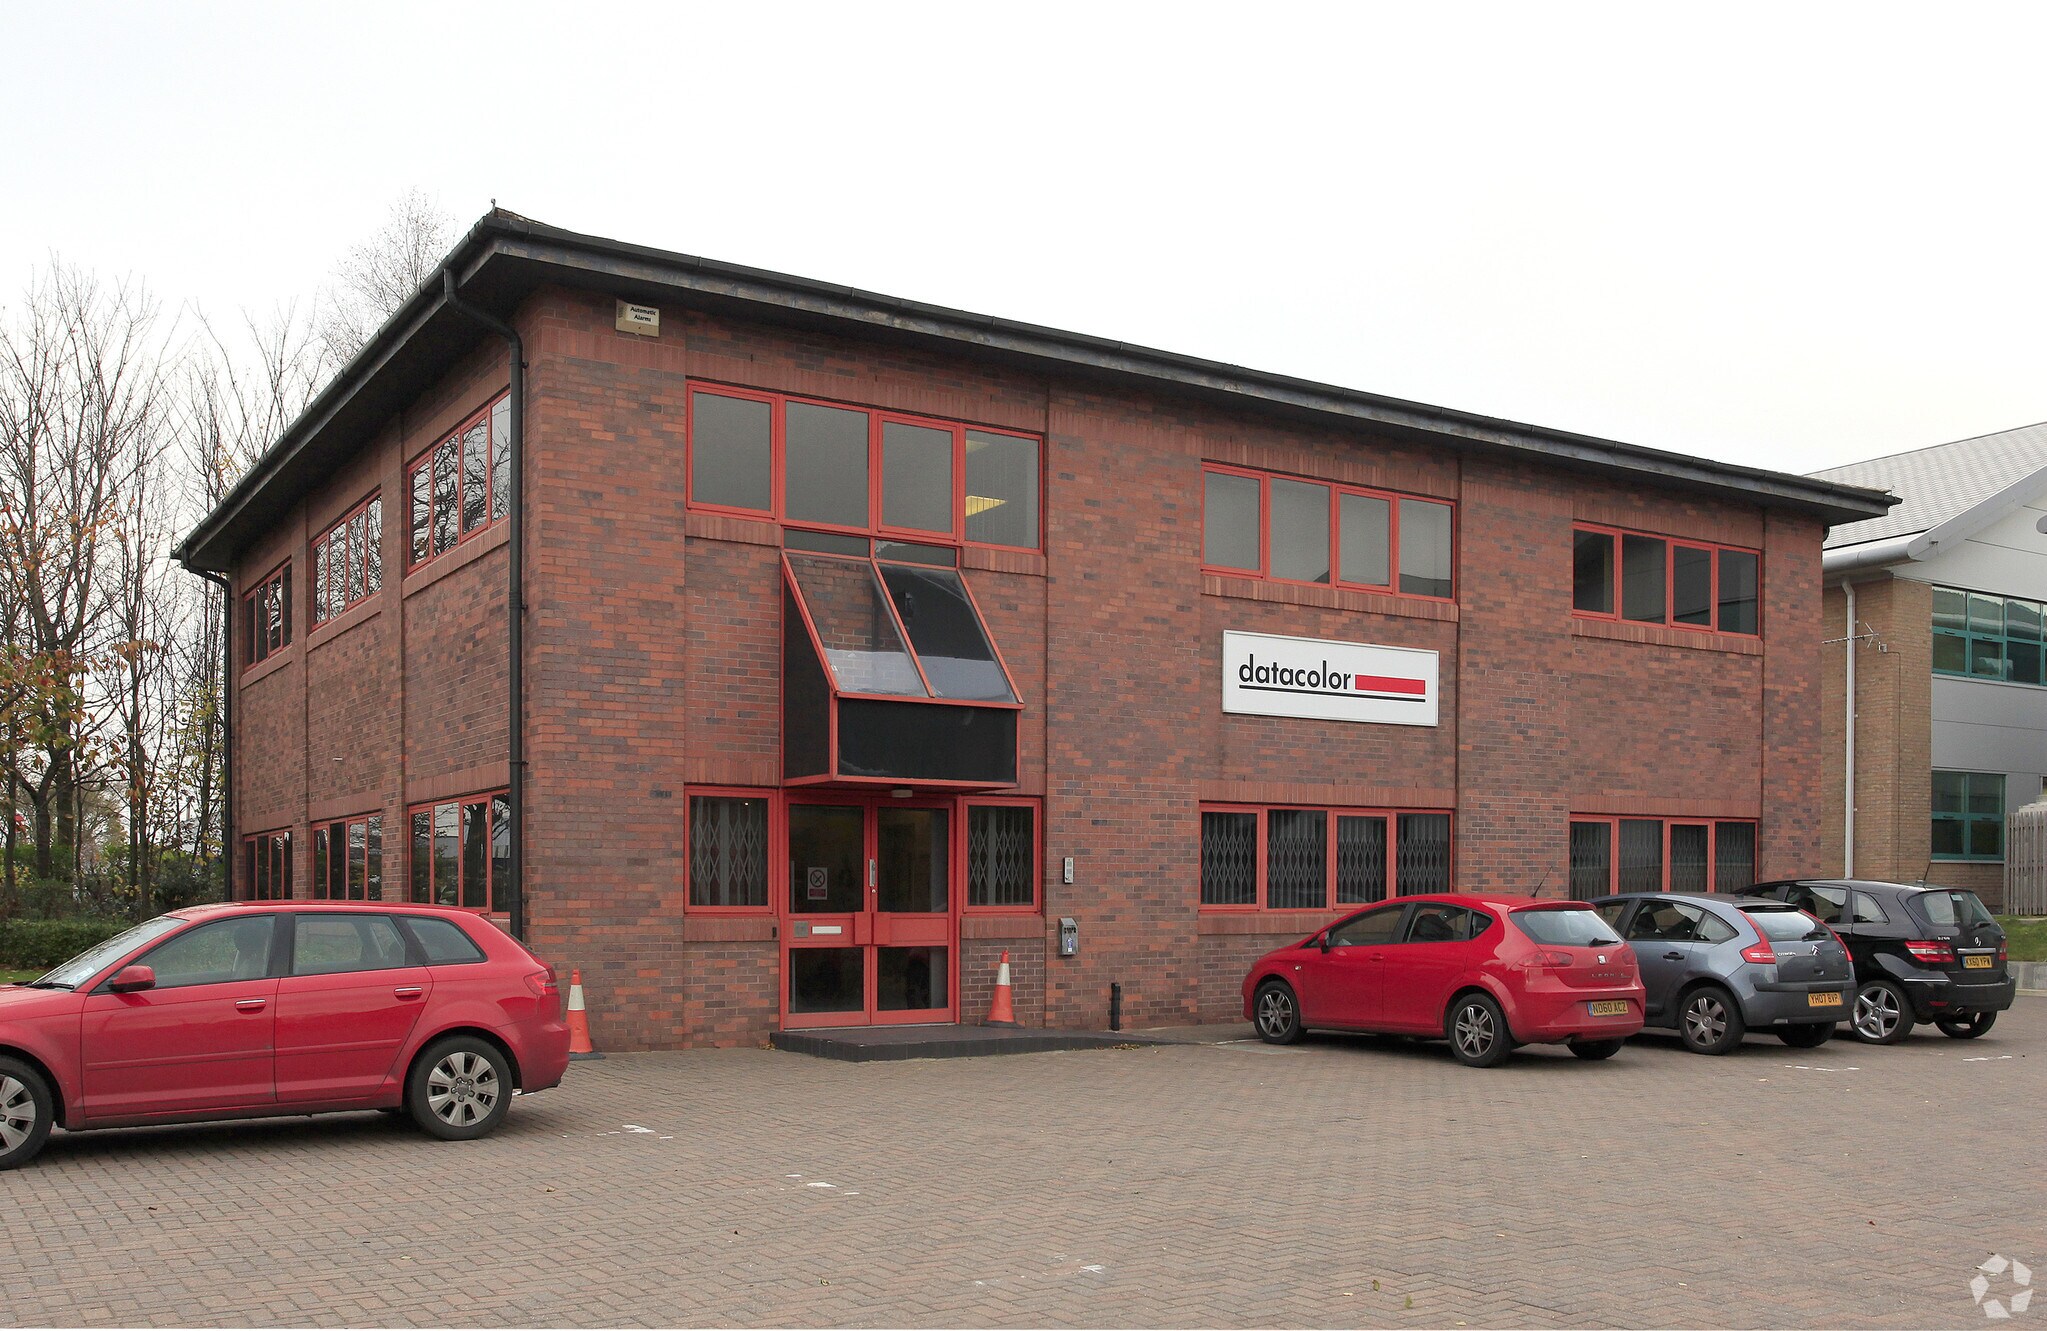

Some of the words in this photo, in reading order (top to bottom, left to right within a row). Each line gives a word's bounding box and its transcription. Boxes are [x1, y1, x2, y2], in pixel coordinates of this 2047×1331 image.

[630, 306, 656, 315] Automatic
[1239, 653, 1351, 690] datacolor
[1810, 994, 1826, 1004] YH07
[1593, 1002, 1613, 1013] ND60
[1614, 1001, 1627, 1012] ACZ
